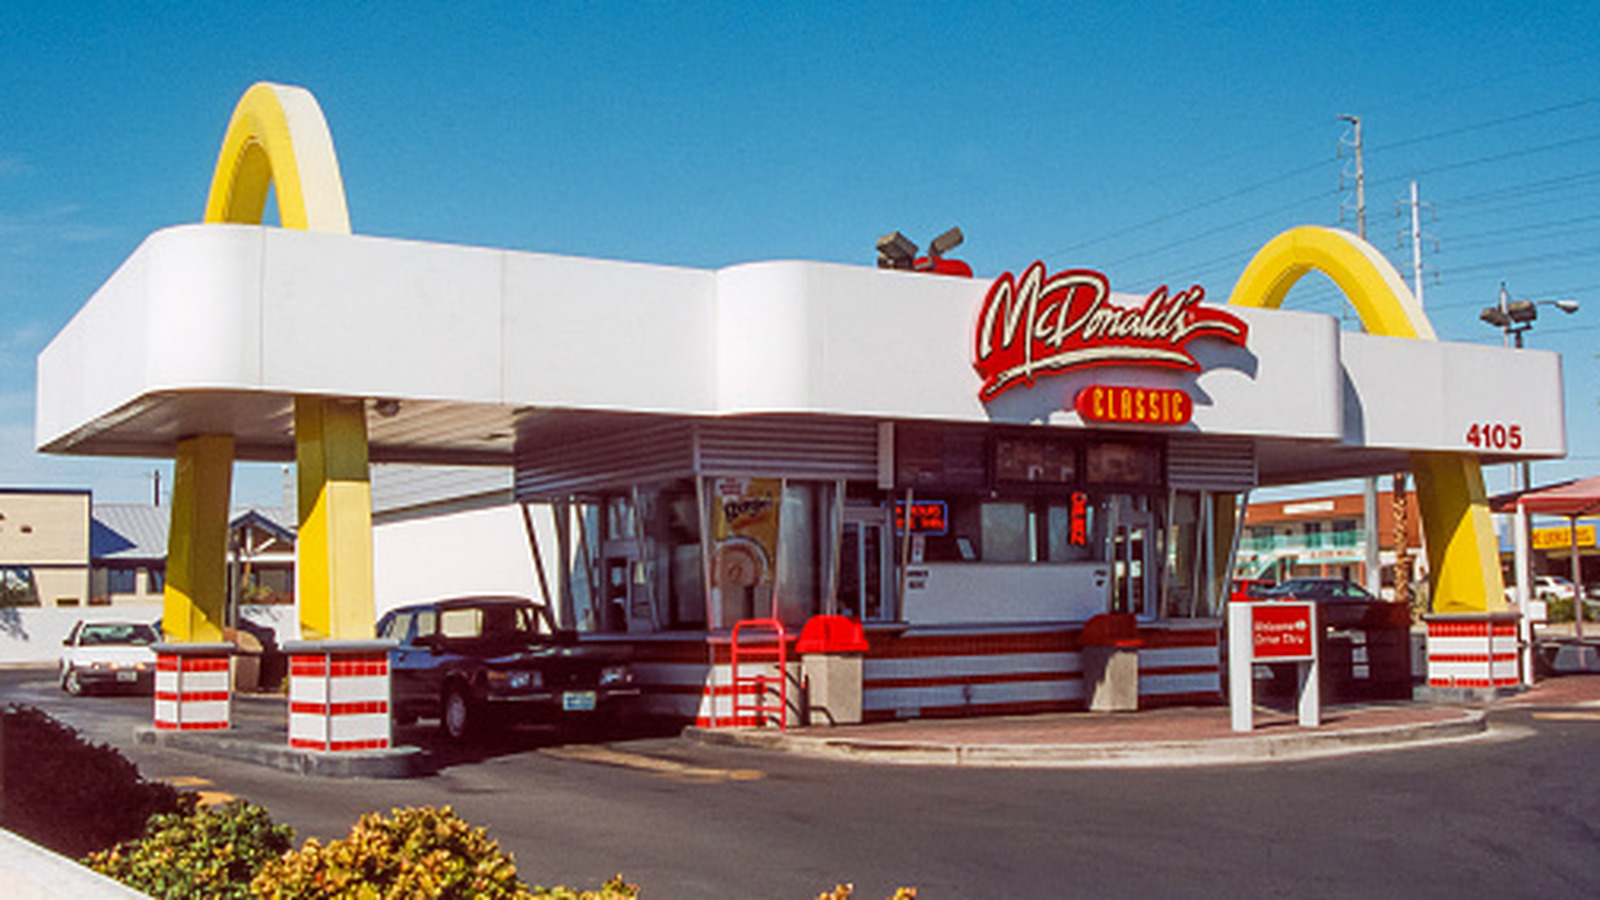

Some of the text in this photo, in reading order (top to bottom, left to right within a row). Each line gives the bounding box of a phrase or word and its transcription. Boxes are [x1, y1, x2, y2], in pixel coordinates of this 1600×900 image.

[979, 264, 1241, 378] McDonald's
[1092, 388, 1183, 421] CLASSIC
[1466, 423, 1523, 450] 4105
